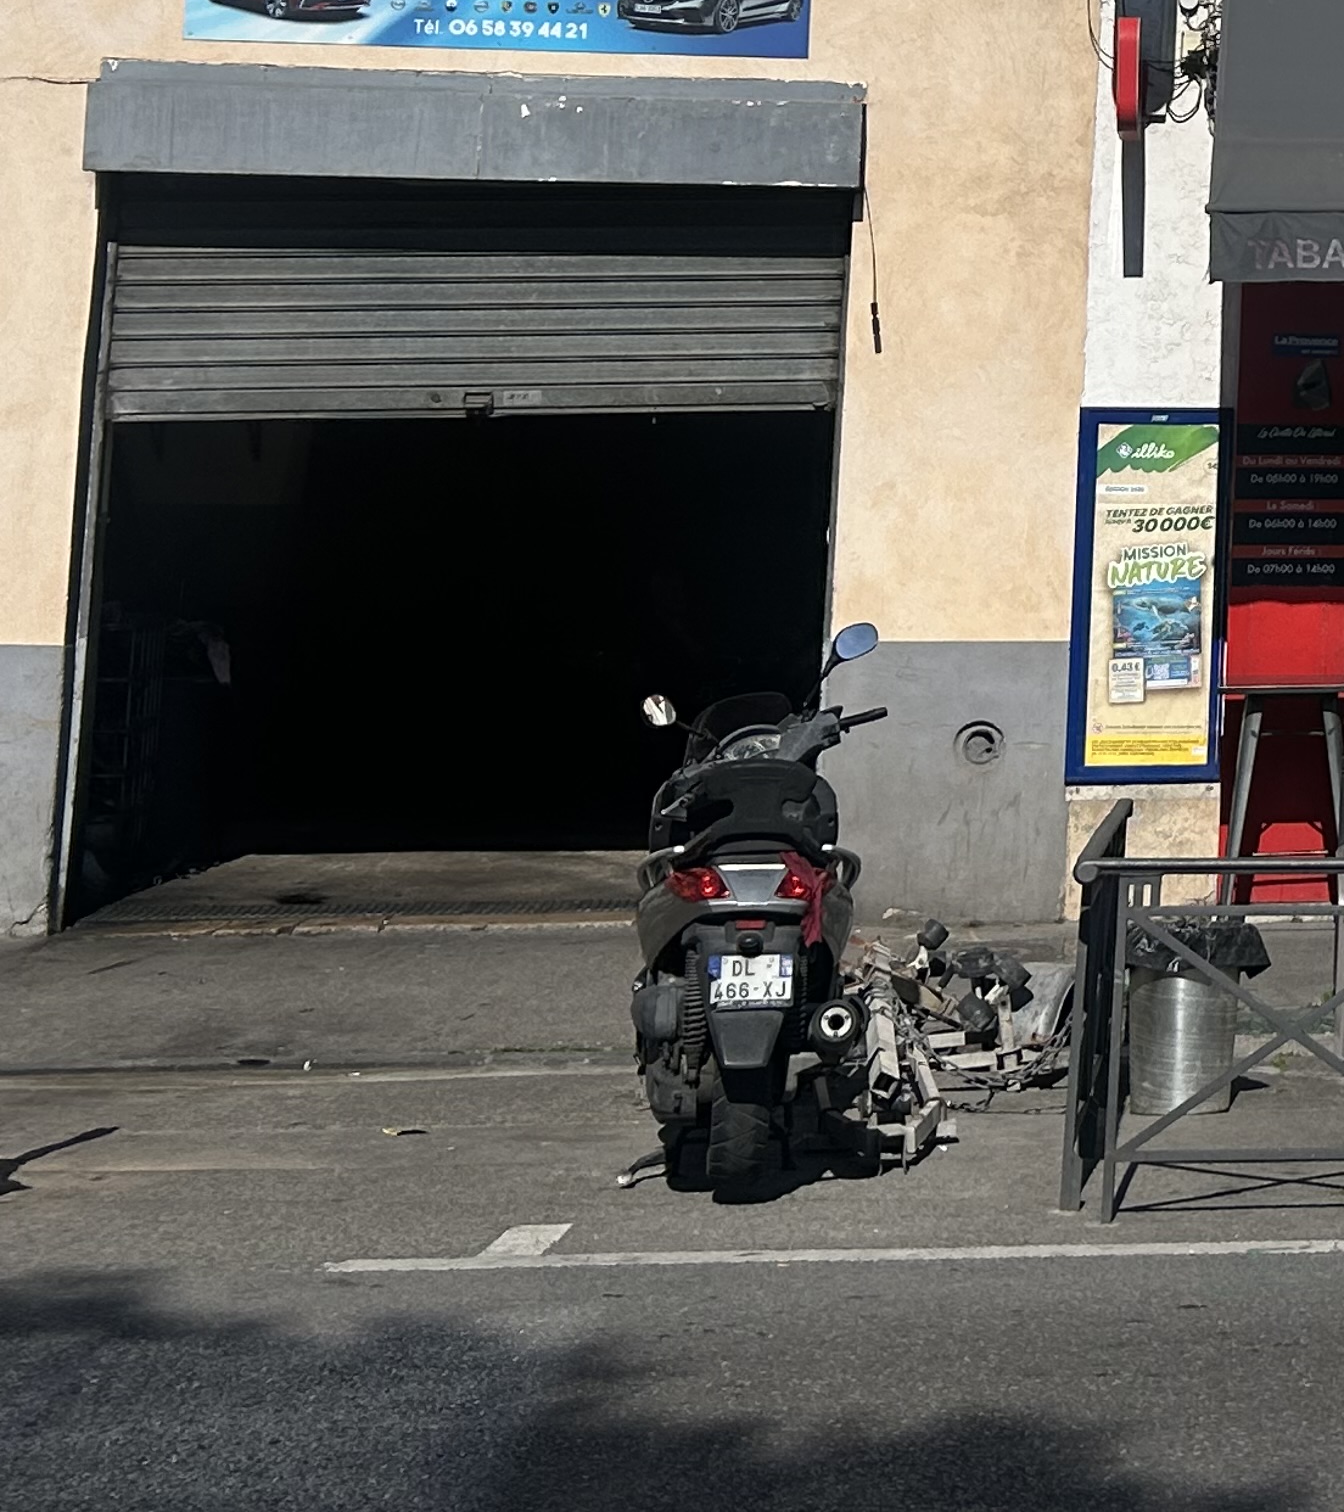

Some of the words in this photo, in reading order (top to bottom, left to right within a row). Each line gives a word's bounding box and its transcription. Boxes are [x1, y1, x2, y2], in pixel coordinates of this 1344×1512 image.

[448, 19, 478, 36] 06
[481, 20, 506, 37] 58
[509, 21, 532, 38] 39
[537, 22, 563, 39] 44
[565, 22, 588, 39] 21
[1105, 508, 1148, 519] TENTEZ
[1149, 507, 1163, 516] DE
[1123, 544, 1188, 562] MISSION
[1110, 555, 1206, 586] NATURE
